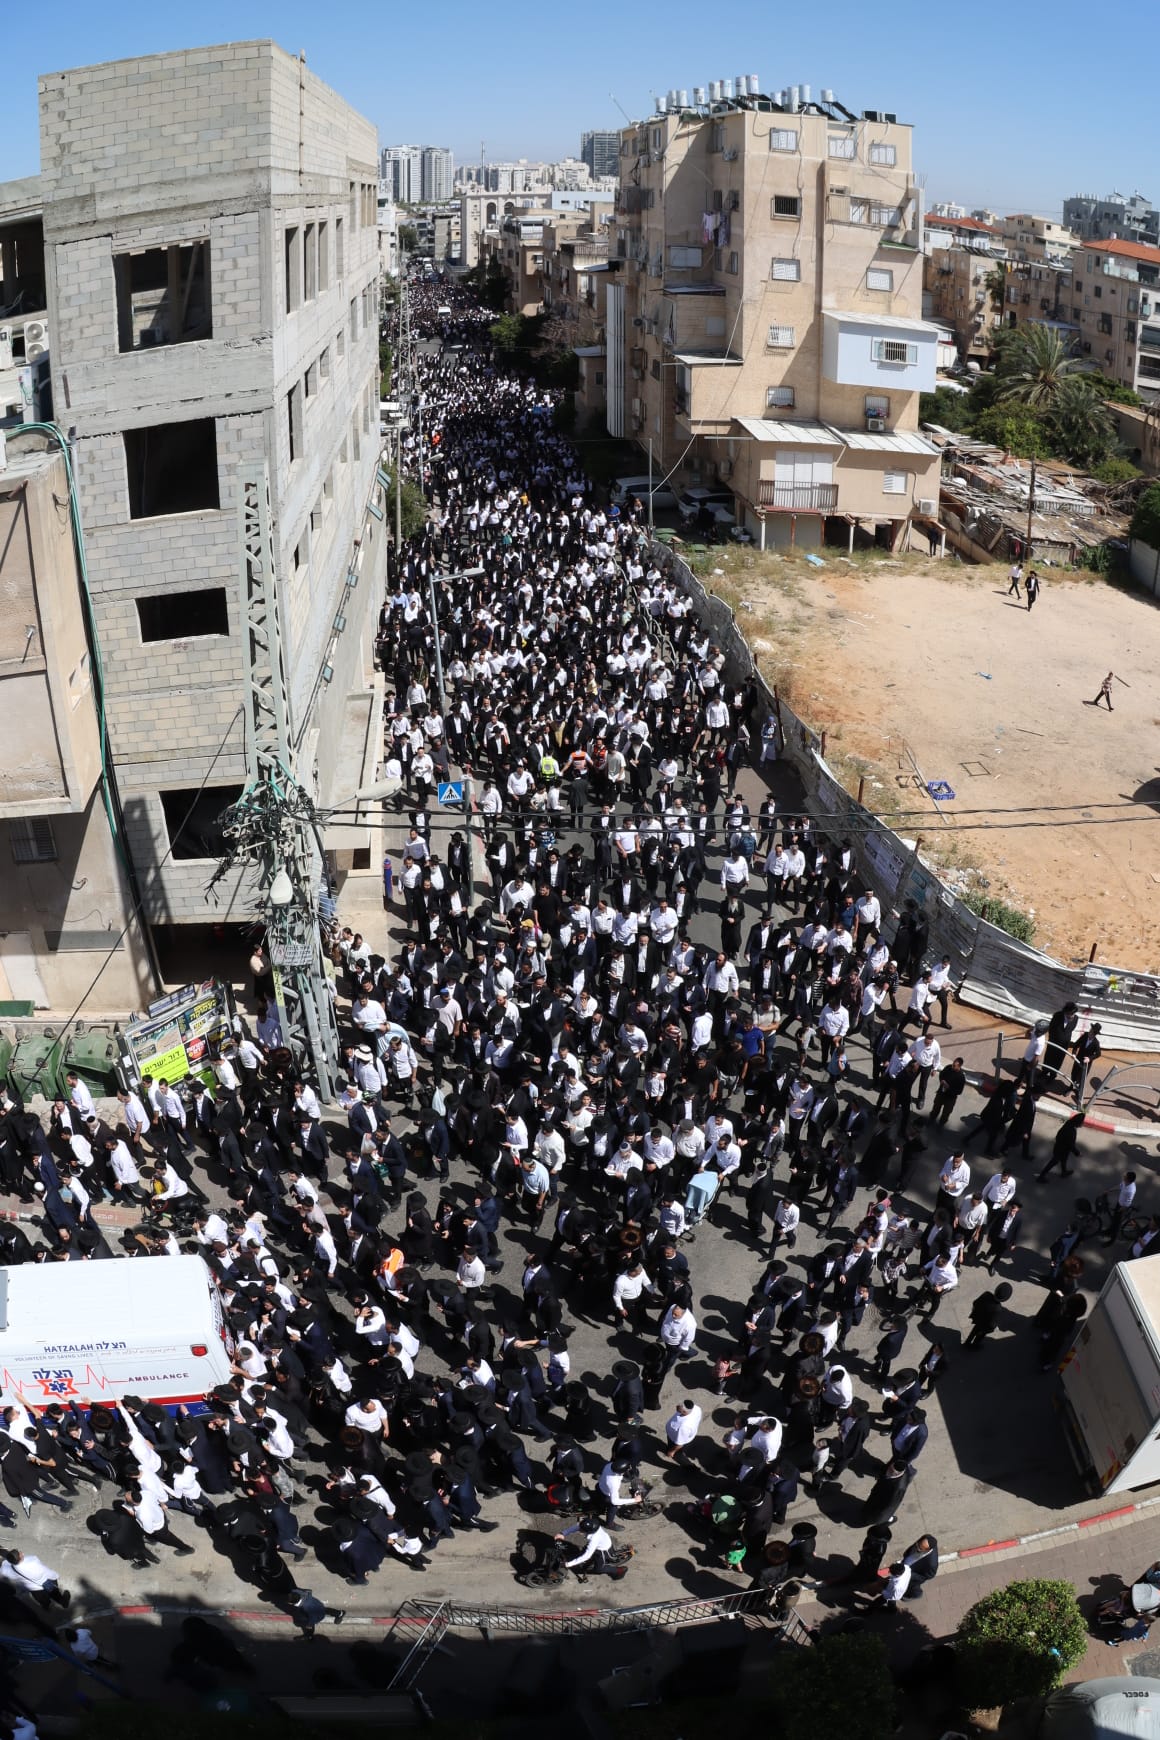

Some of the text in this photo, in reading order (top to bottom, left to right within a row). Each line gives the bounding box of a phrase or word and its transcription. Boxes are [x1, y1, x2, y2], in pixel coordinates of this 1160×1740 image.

[44, 1344, 94, 1353] HATZALAH
[96, 1341, 127, 1350] הצלה
[32, 1368, 73, 1379] הצלה
[128, 1373, 189, 1382] AMBULANCE
